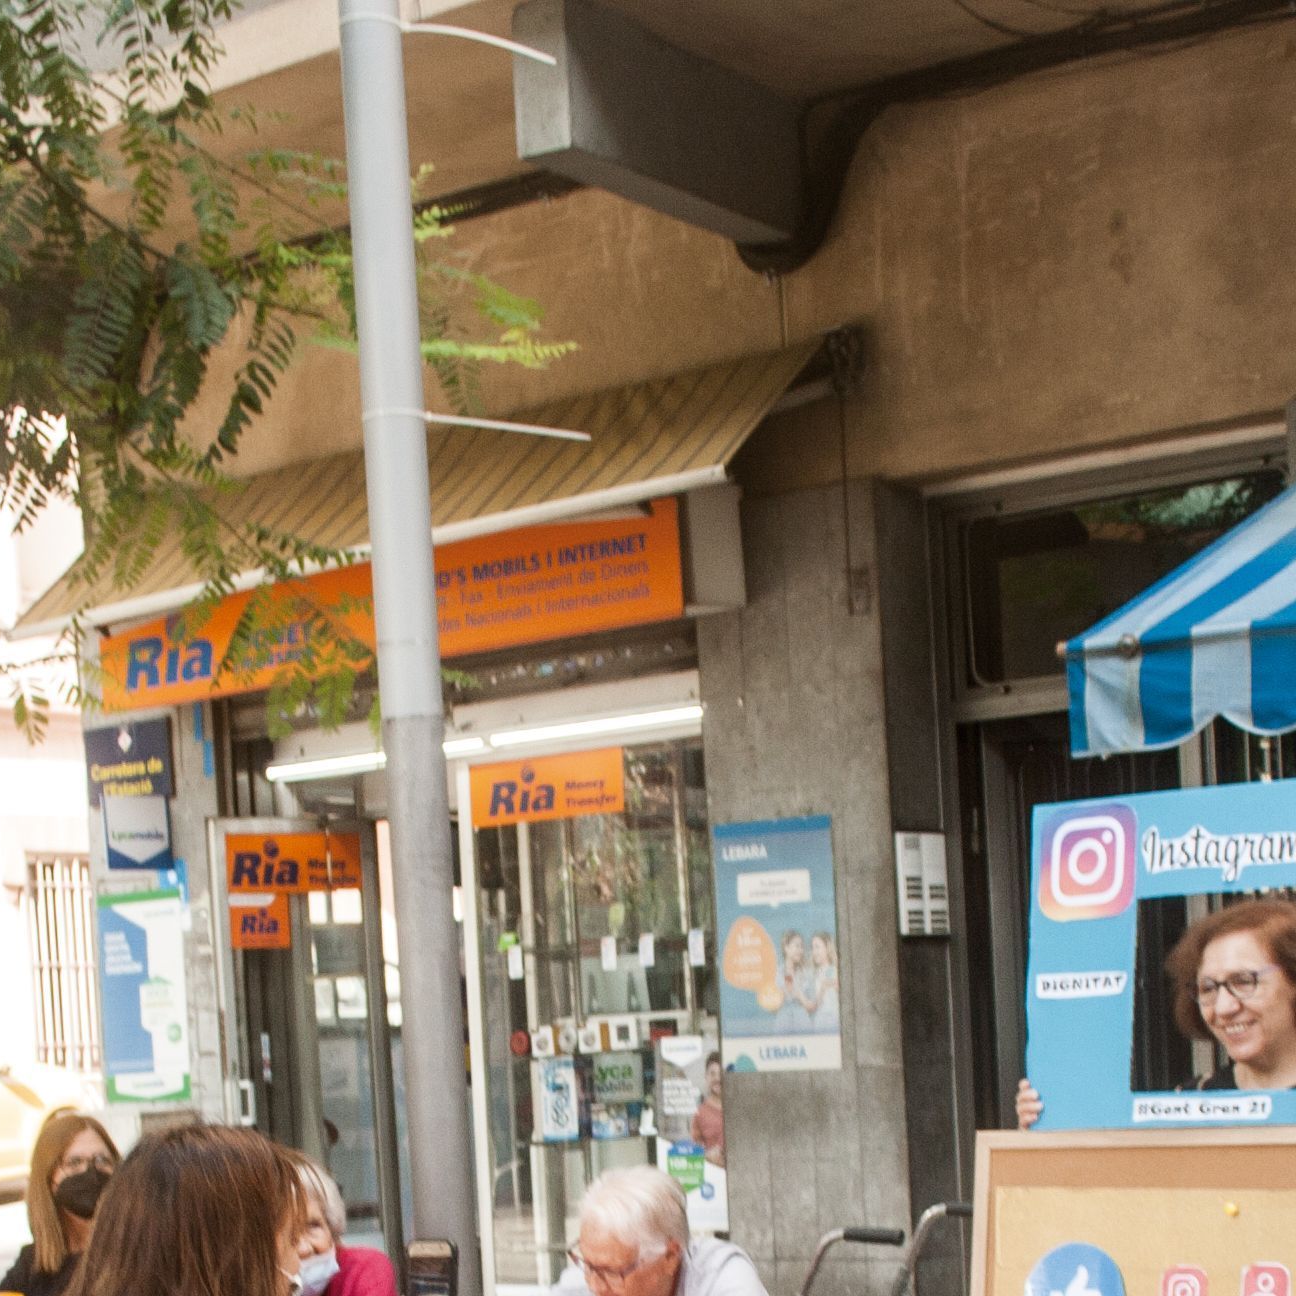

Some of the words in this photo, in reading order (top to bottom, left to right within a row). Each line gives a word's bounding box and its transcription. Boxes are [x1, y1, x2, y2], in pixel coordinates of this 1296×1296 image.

[471, 552, 541, 582] MOBILS
[557, 533, 648, 567] INTERNET
[126, 612, 214, 691] Ria
[489, 765, 557, 818] Ria
[232, 839, 299, 887] Ria
[241, 907, 280, 936] Ria
[1041, 976, 1122, 992] DIGNITAT
